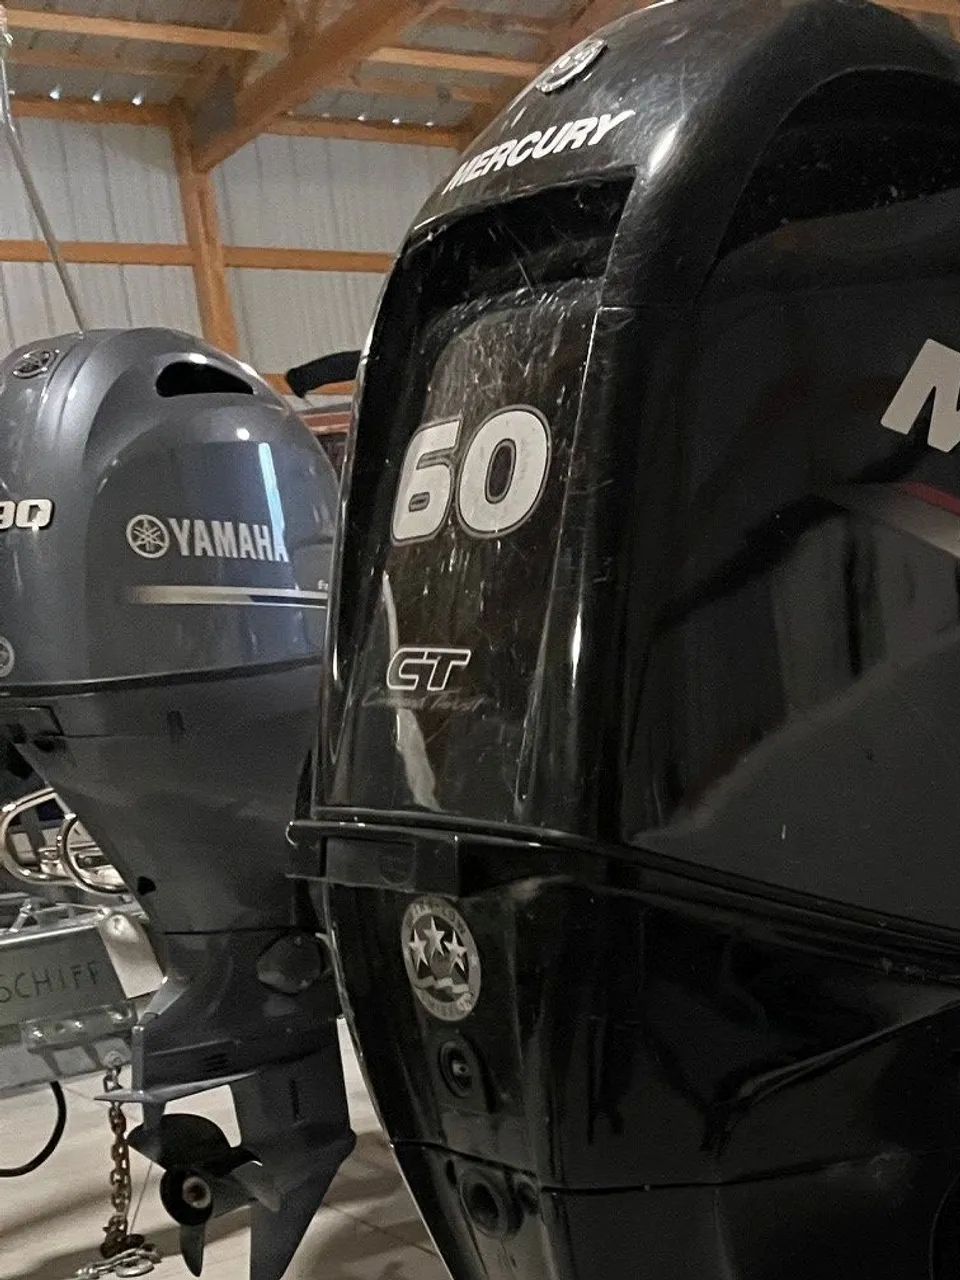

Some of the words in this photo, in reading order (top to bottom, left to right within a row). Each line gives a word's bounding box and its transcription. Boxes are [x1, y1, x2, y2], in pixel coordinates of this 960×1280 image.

[441, 109, 636, 195] MERCURY
[391, 404, 551, 545] 60
[168, 518, 289, 562] YAMAHA
[386, 647, 471, 691] CT
